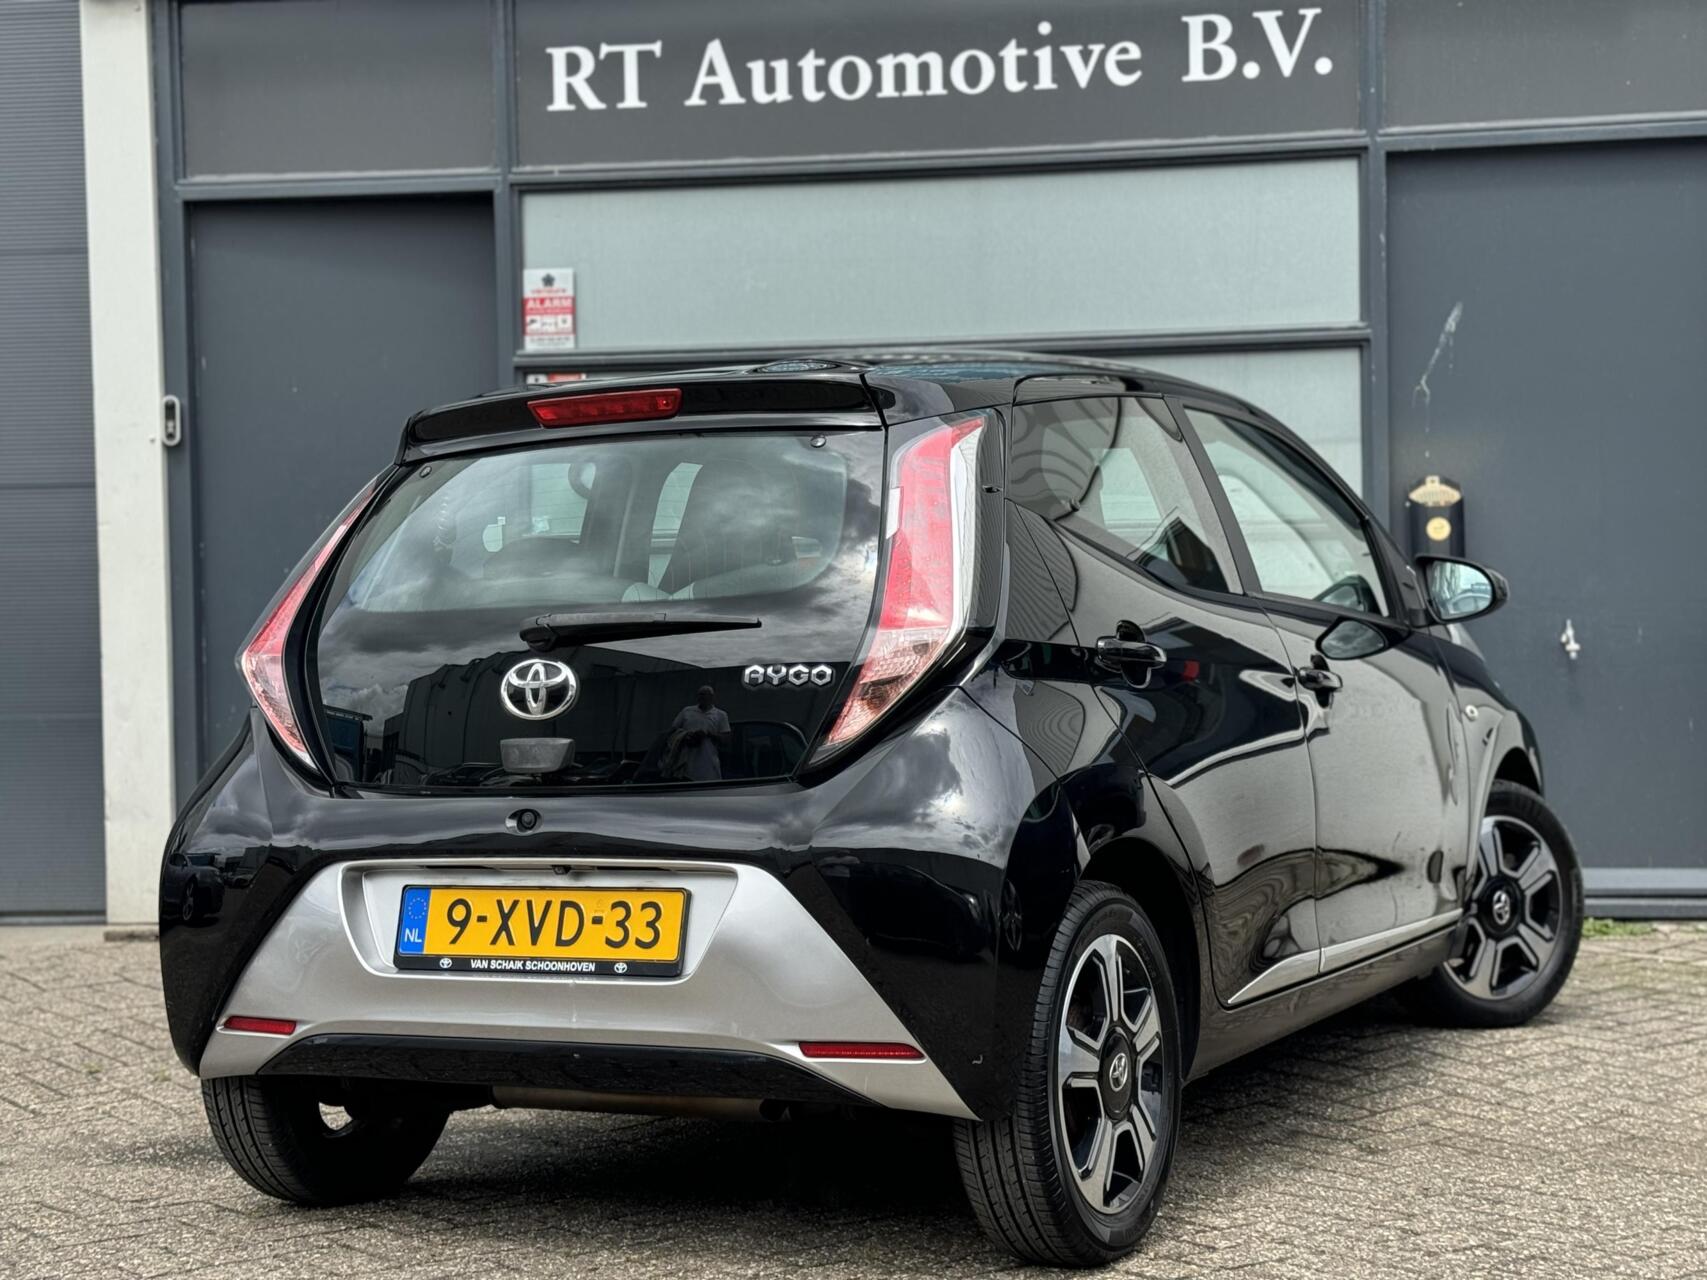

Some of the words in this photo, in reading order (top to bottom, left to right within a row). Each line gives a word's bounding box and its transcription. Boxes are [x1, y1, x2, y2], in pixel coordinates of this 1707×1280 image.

[545, 42, 662, 112] RT
[685, 22, 1143, 107] Automotive
[1181, 7, 1334, 83] B.V.
[743, 664, 832, 686] AYGO
[446, 897, 663, 950] 9-XVD-33
[404, 927, 422, 943] NL
[470, 958, 488, 970] VAN
[490, 959, 523, 970] SCHAIK
[525, 961, 596, 973] SCHOONHOVEN
